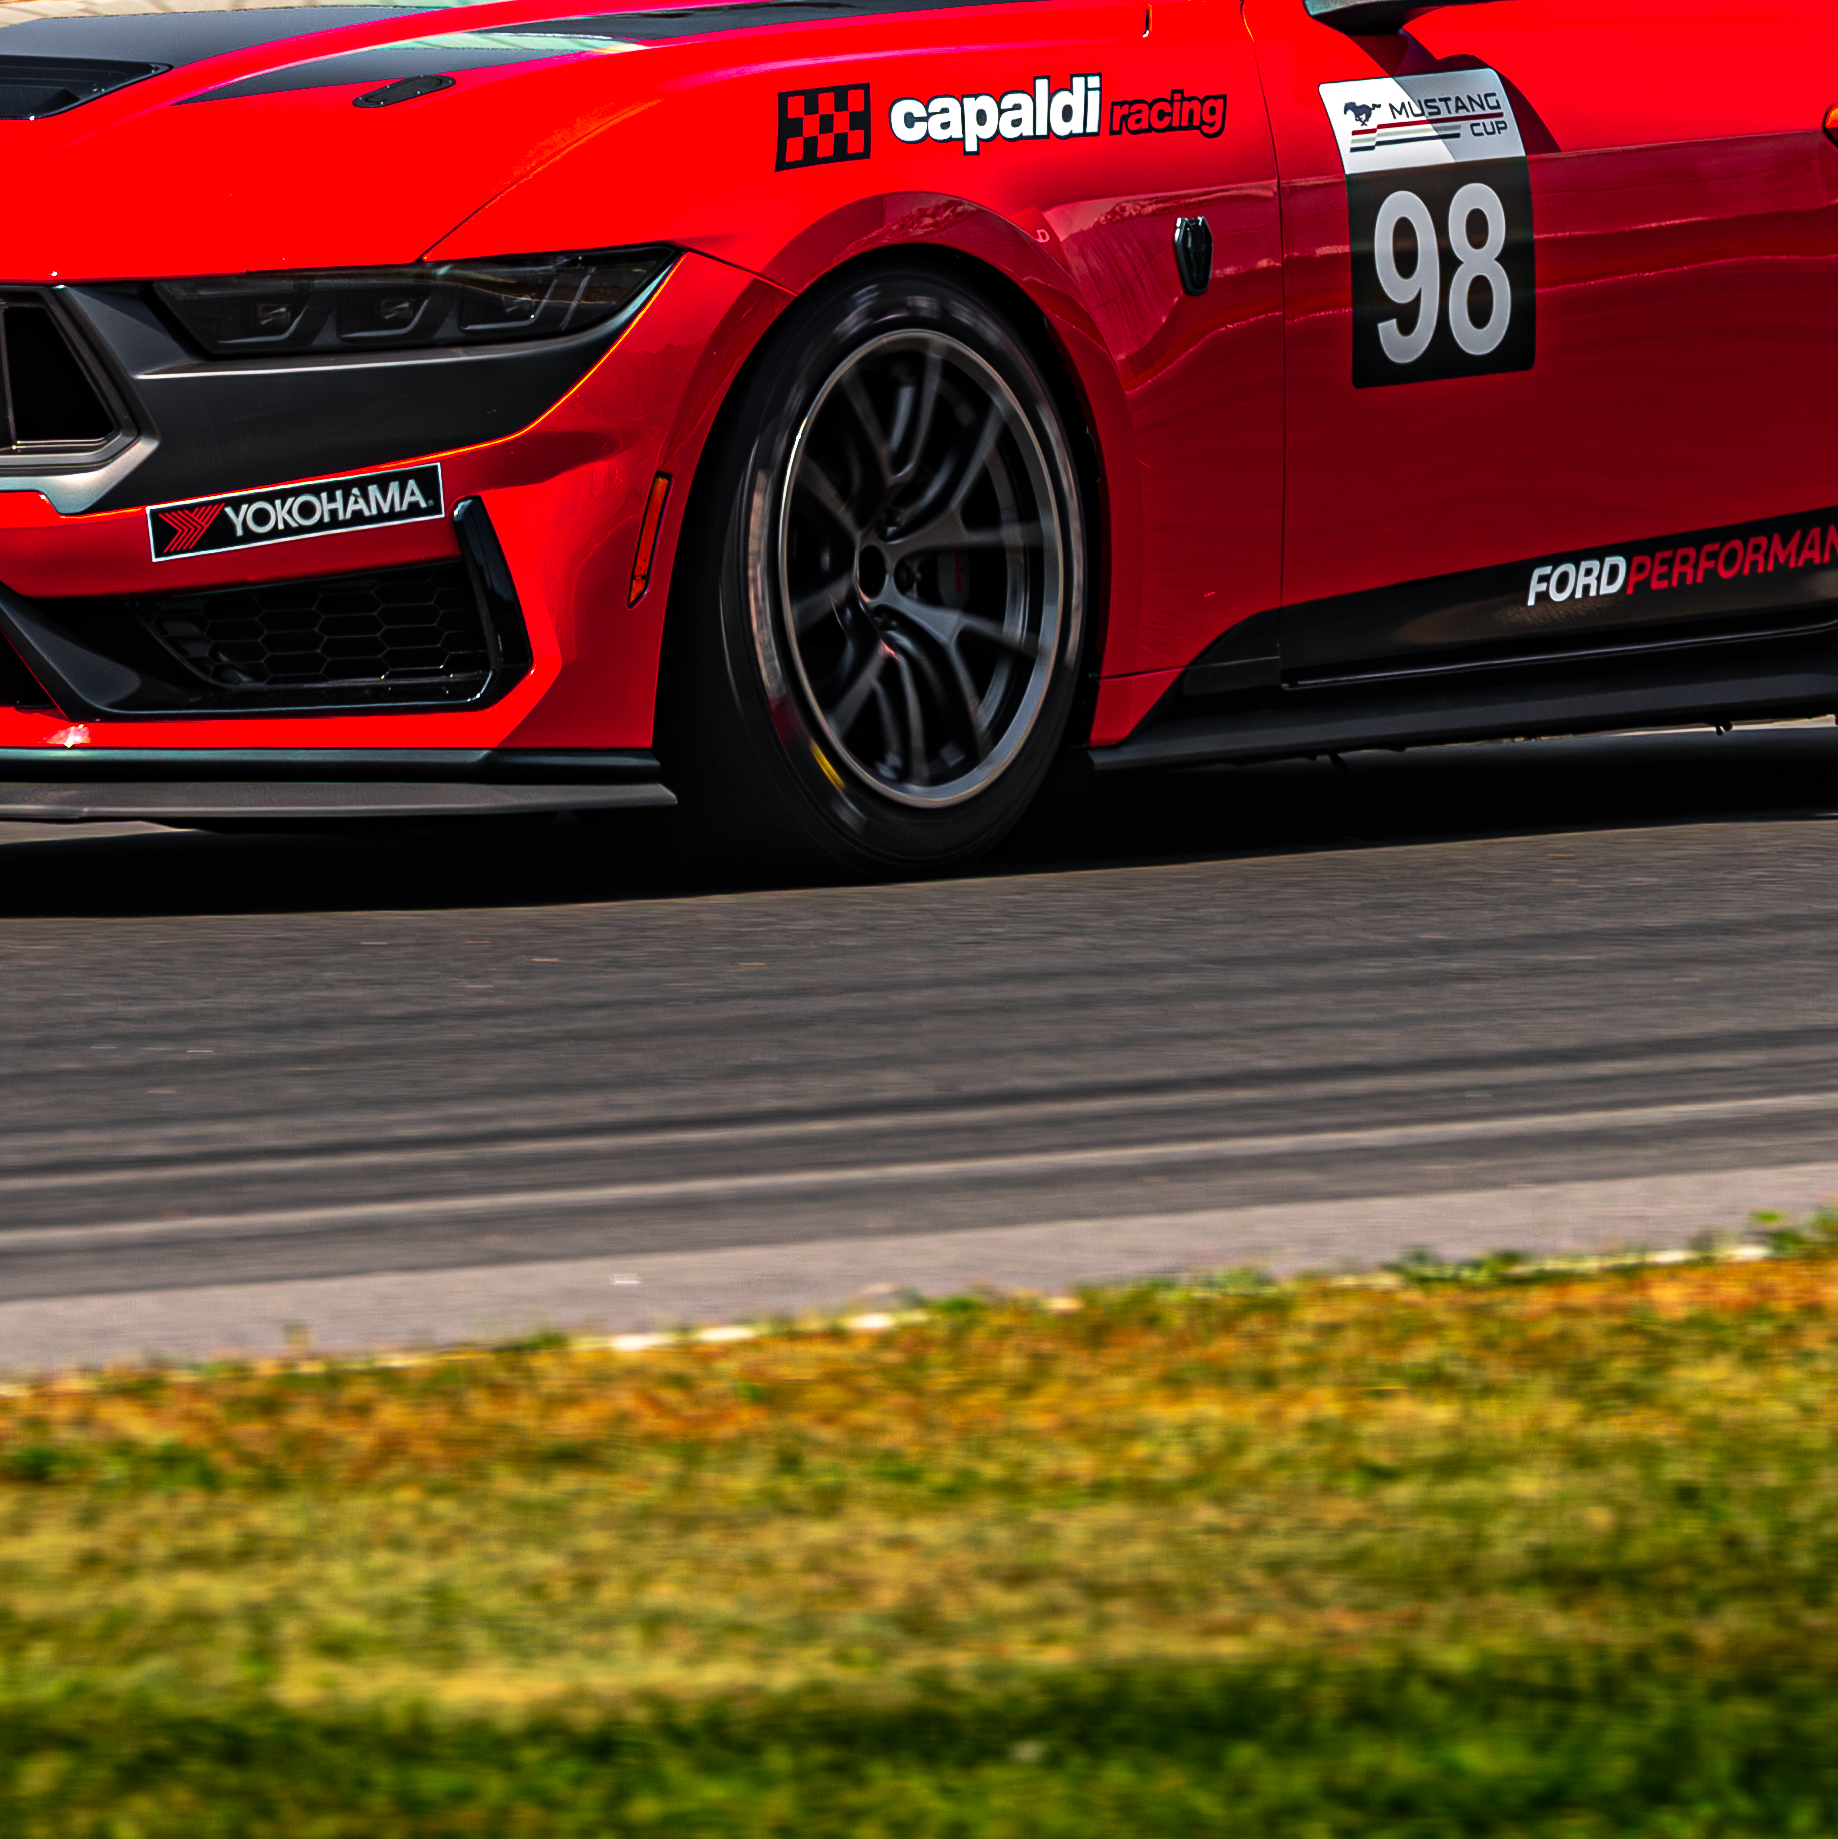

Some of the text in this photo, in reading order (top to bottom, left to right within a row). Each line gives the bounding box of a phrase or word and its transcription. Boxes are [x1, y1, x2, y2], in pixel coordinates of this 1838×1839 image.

[888, 72, 1227, 156] capaldi racing
[1388, 92, 1502, 120] MUSTANG
[1469, 119, 1509, 138] CUP
[1373, 181, 1512, 365] 98
[223, 478, 428, 537] YOKOHAMA
